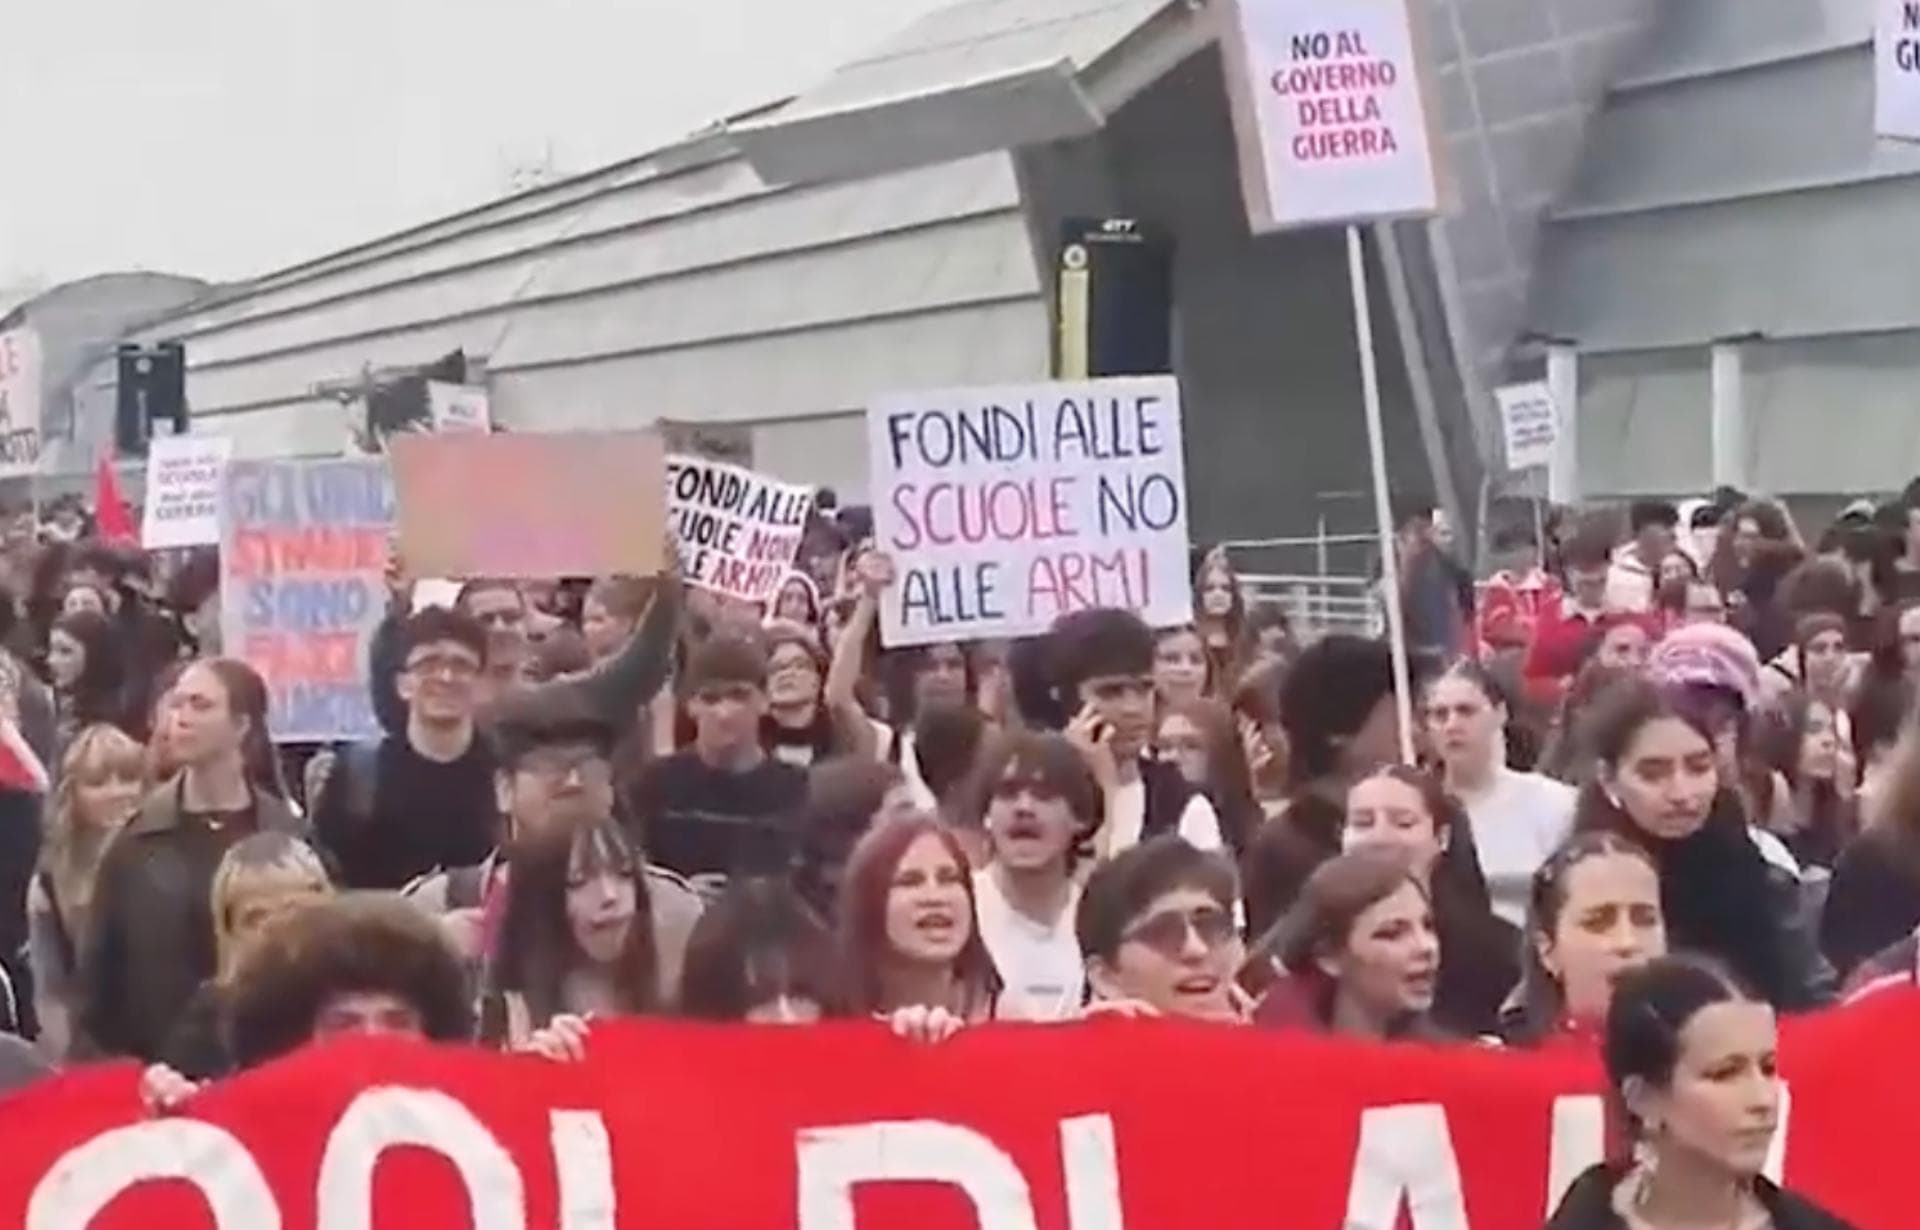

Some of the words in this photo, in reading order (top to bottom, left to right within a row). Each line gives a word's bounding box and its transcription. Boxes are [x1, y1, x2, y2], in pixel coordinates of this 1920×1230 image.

[1292, 32, 1330, 61] NO
[1335, 30, 1368, 58] AL
[1270, 61, 1397, 95] GOVERNO
[1298, 95, 1381, 127] DELLA
[1292, 127, 1397, 161] GUERRA
[888, 401, 1038, 469] FONDI
[1054, 396, 1163, 461] ALLE
[750, 485, 807, 525] ALLE
[892, 476, 1080, 550] SCUOLE
[1098, 472, 1180, 537] NO
[671, 507, 742, 555] UOLE
[901, 562, 1005, 627] ALLE
[1027, 548, 1151, 616] ARMI
